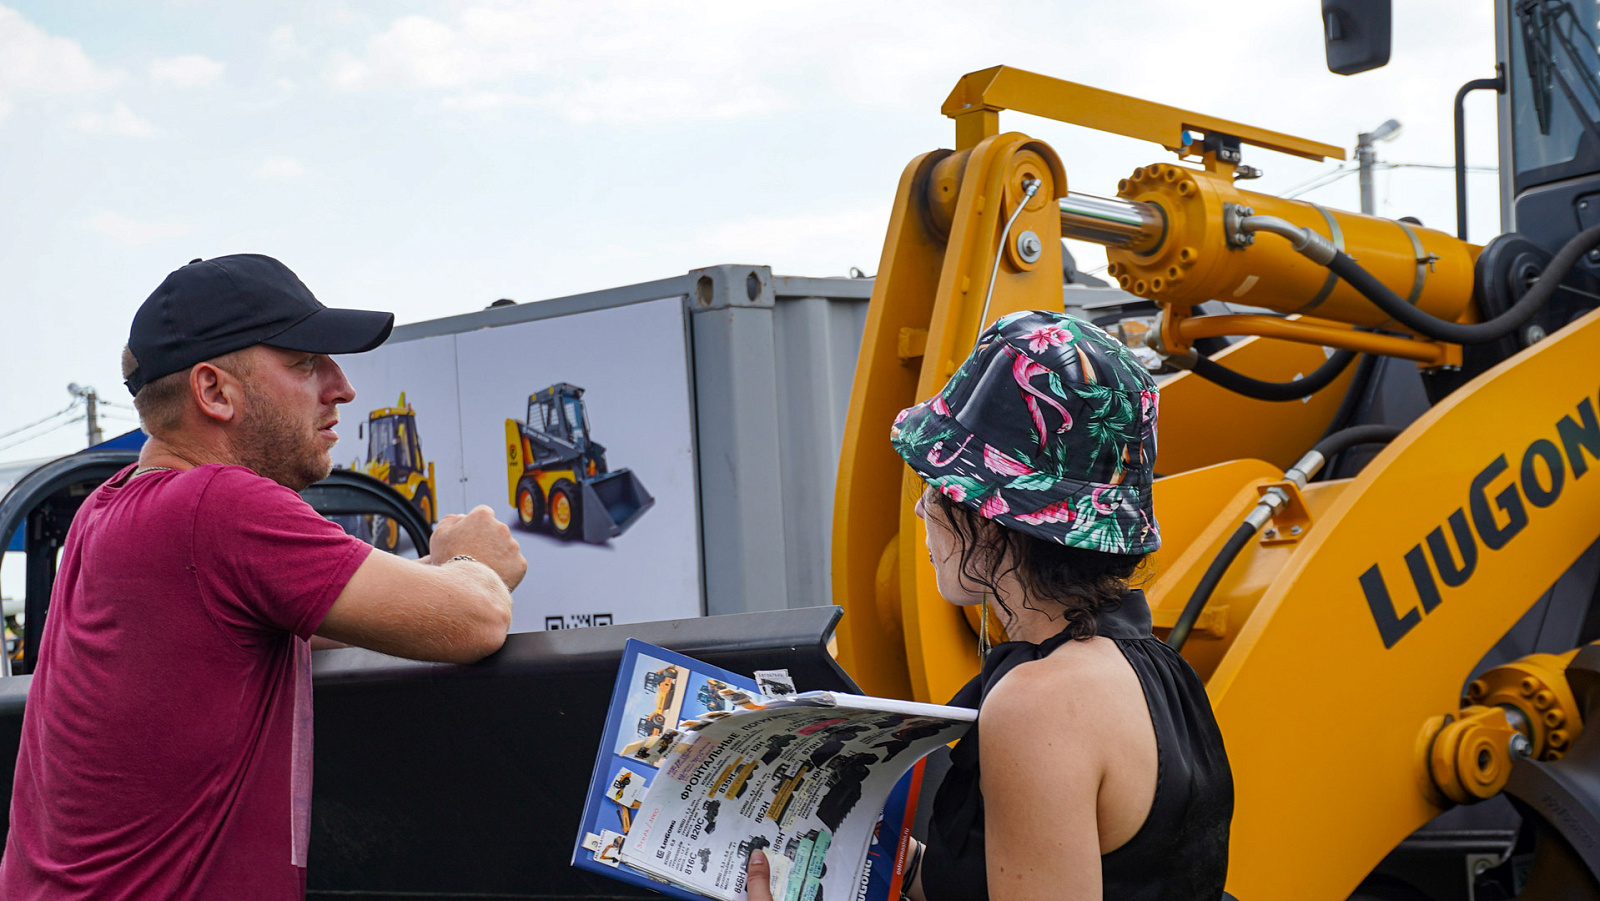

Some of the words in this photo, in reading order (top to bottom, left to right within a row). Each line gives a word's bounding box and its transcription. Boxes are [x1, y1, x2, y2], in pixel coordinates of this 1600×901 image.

[1358, 386, 1600, 650] LIUGON
[679, 730, 740, 801] ФРОНТАЛЬНЫЕ
[717, 772, 735, 794] 835H
[753, 800, 770, 823] 862H
[689, 817, 704, 840] 820C
[683, 852, 697, 874] 816C
[733, 871, 746, 893] 856H
